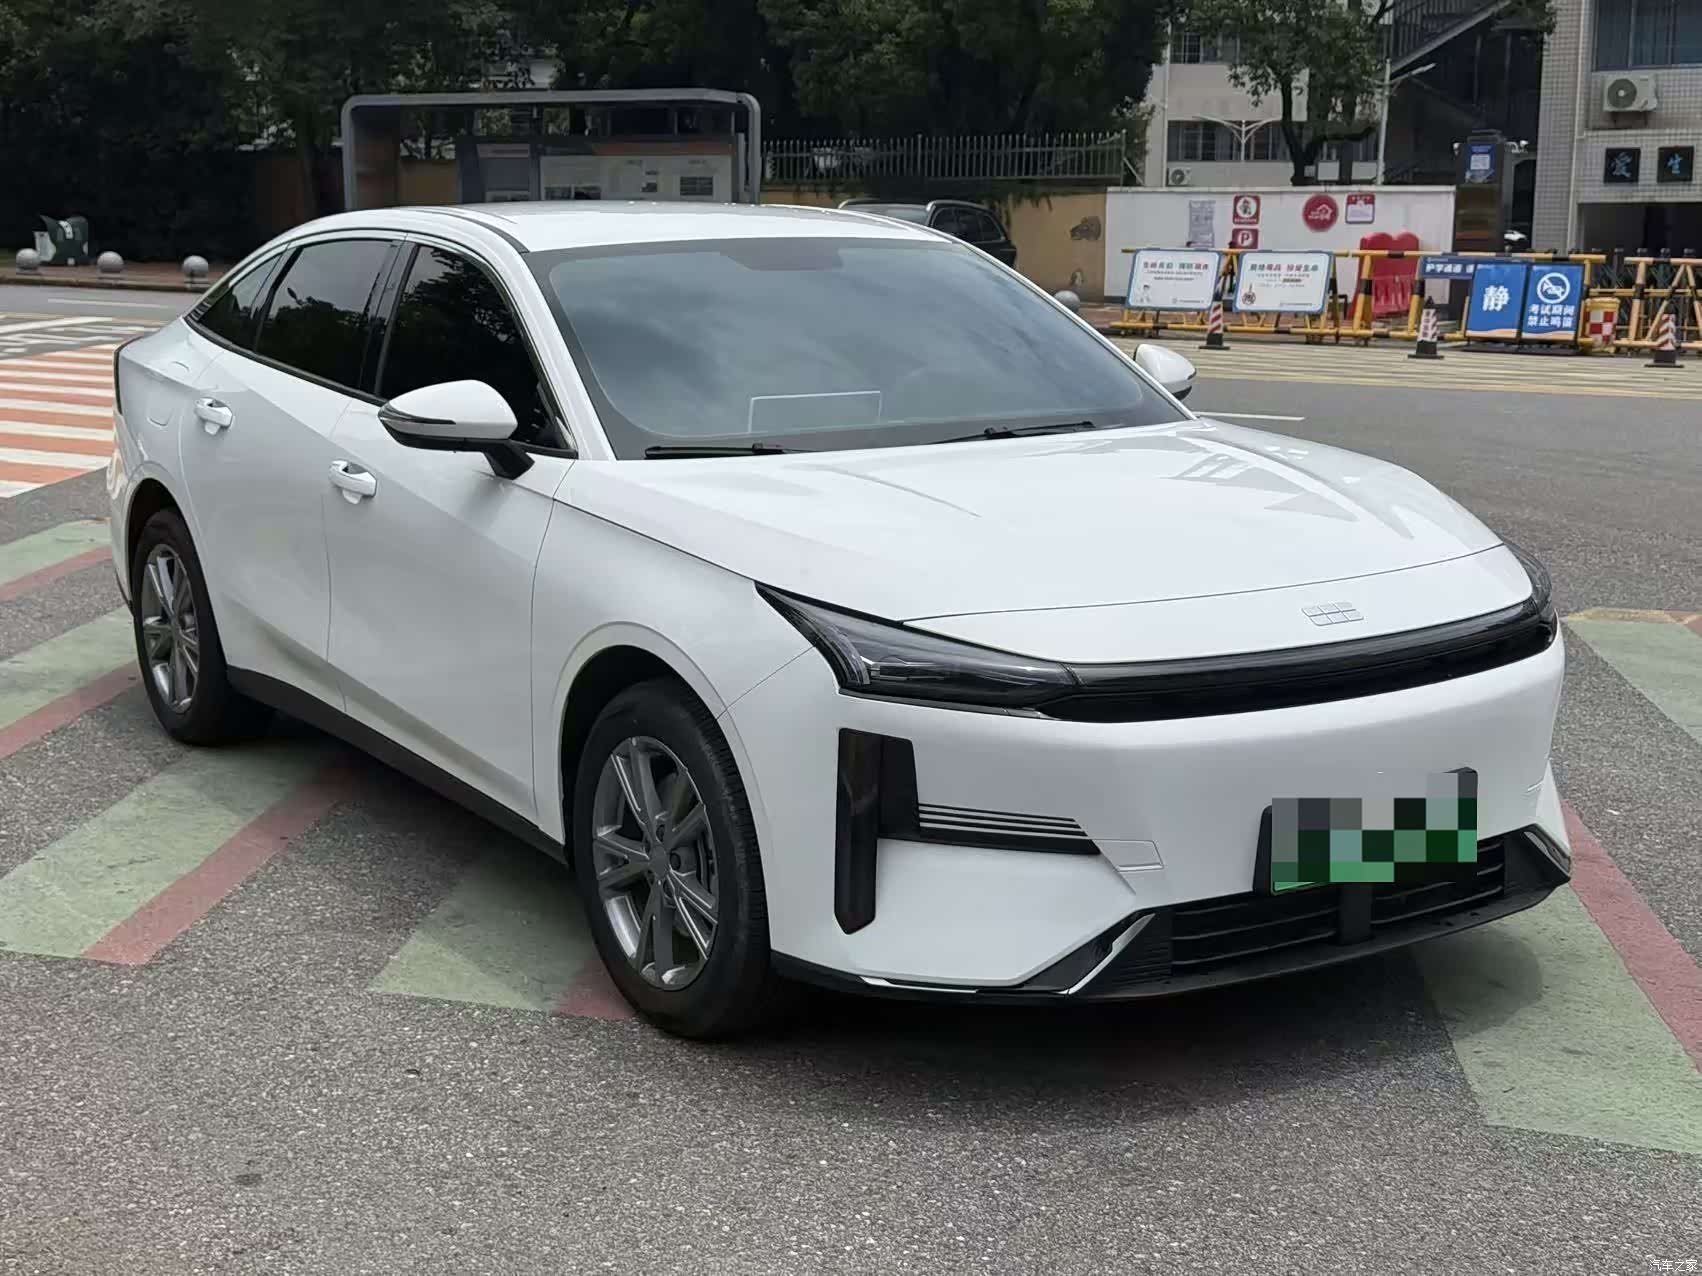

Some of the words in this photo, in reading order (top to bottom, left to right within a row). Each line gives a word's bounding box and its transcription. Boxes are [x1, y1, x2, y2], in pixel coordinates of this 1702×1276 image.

[1241, 232, 1250, 245] P
[1482, 285, 1510, 311] 静
[1528, 303, 1575, 316] 考试期间
[1527, 315, 1573, 328] 禁止鸣笛
